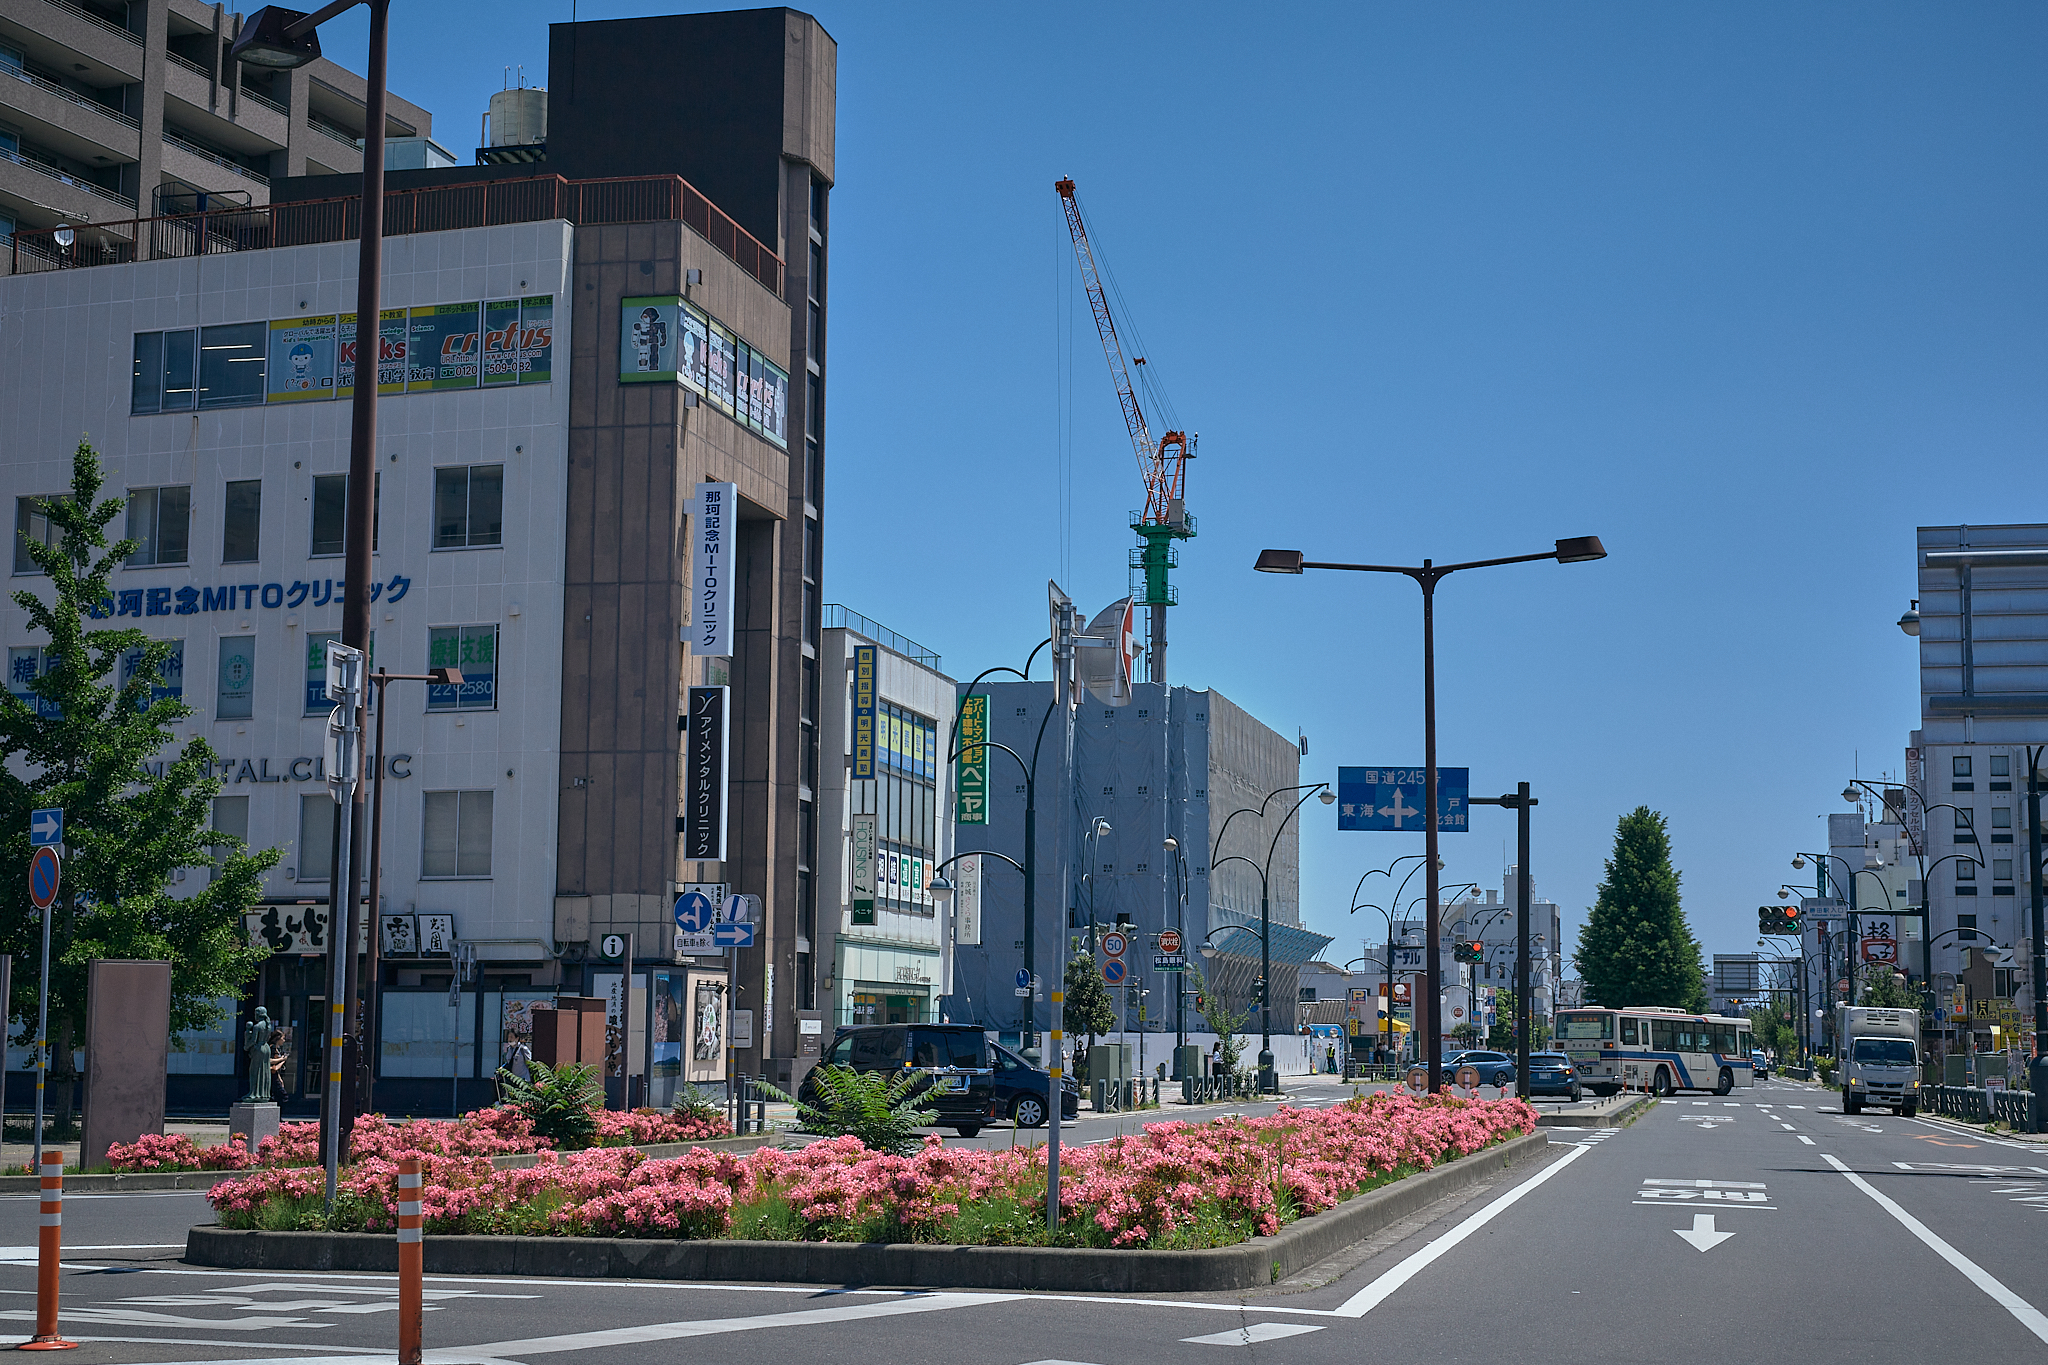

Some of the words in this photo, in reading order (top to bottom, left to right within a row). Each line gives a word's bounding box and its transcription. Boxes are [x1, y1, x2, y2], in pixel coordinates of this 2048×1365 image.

[702, 490, 720, 647] 那珂記念MITOクリニック
[697, 716, 713, 857] アイメンタルクリニック
[962, 765, 983, 813] ベニヤ
[1341, 803, 1375, 818] 東海
[677, 938, 711, 948] 自転車を除く
[1107, 939, 1122, 951] 50
[1161, 936, 1179, 946] 消火栓
[1353, 991, 1364, 1000] P
